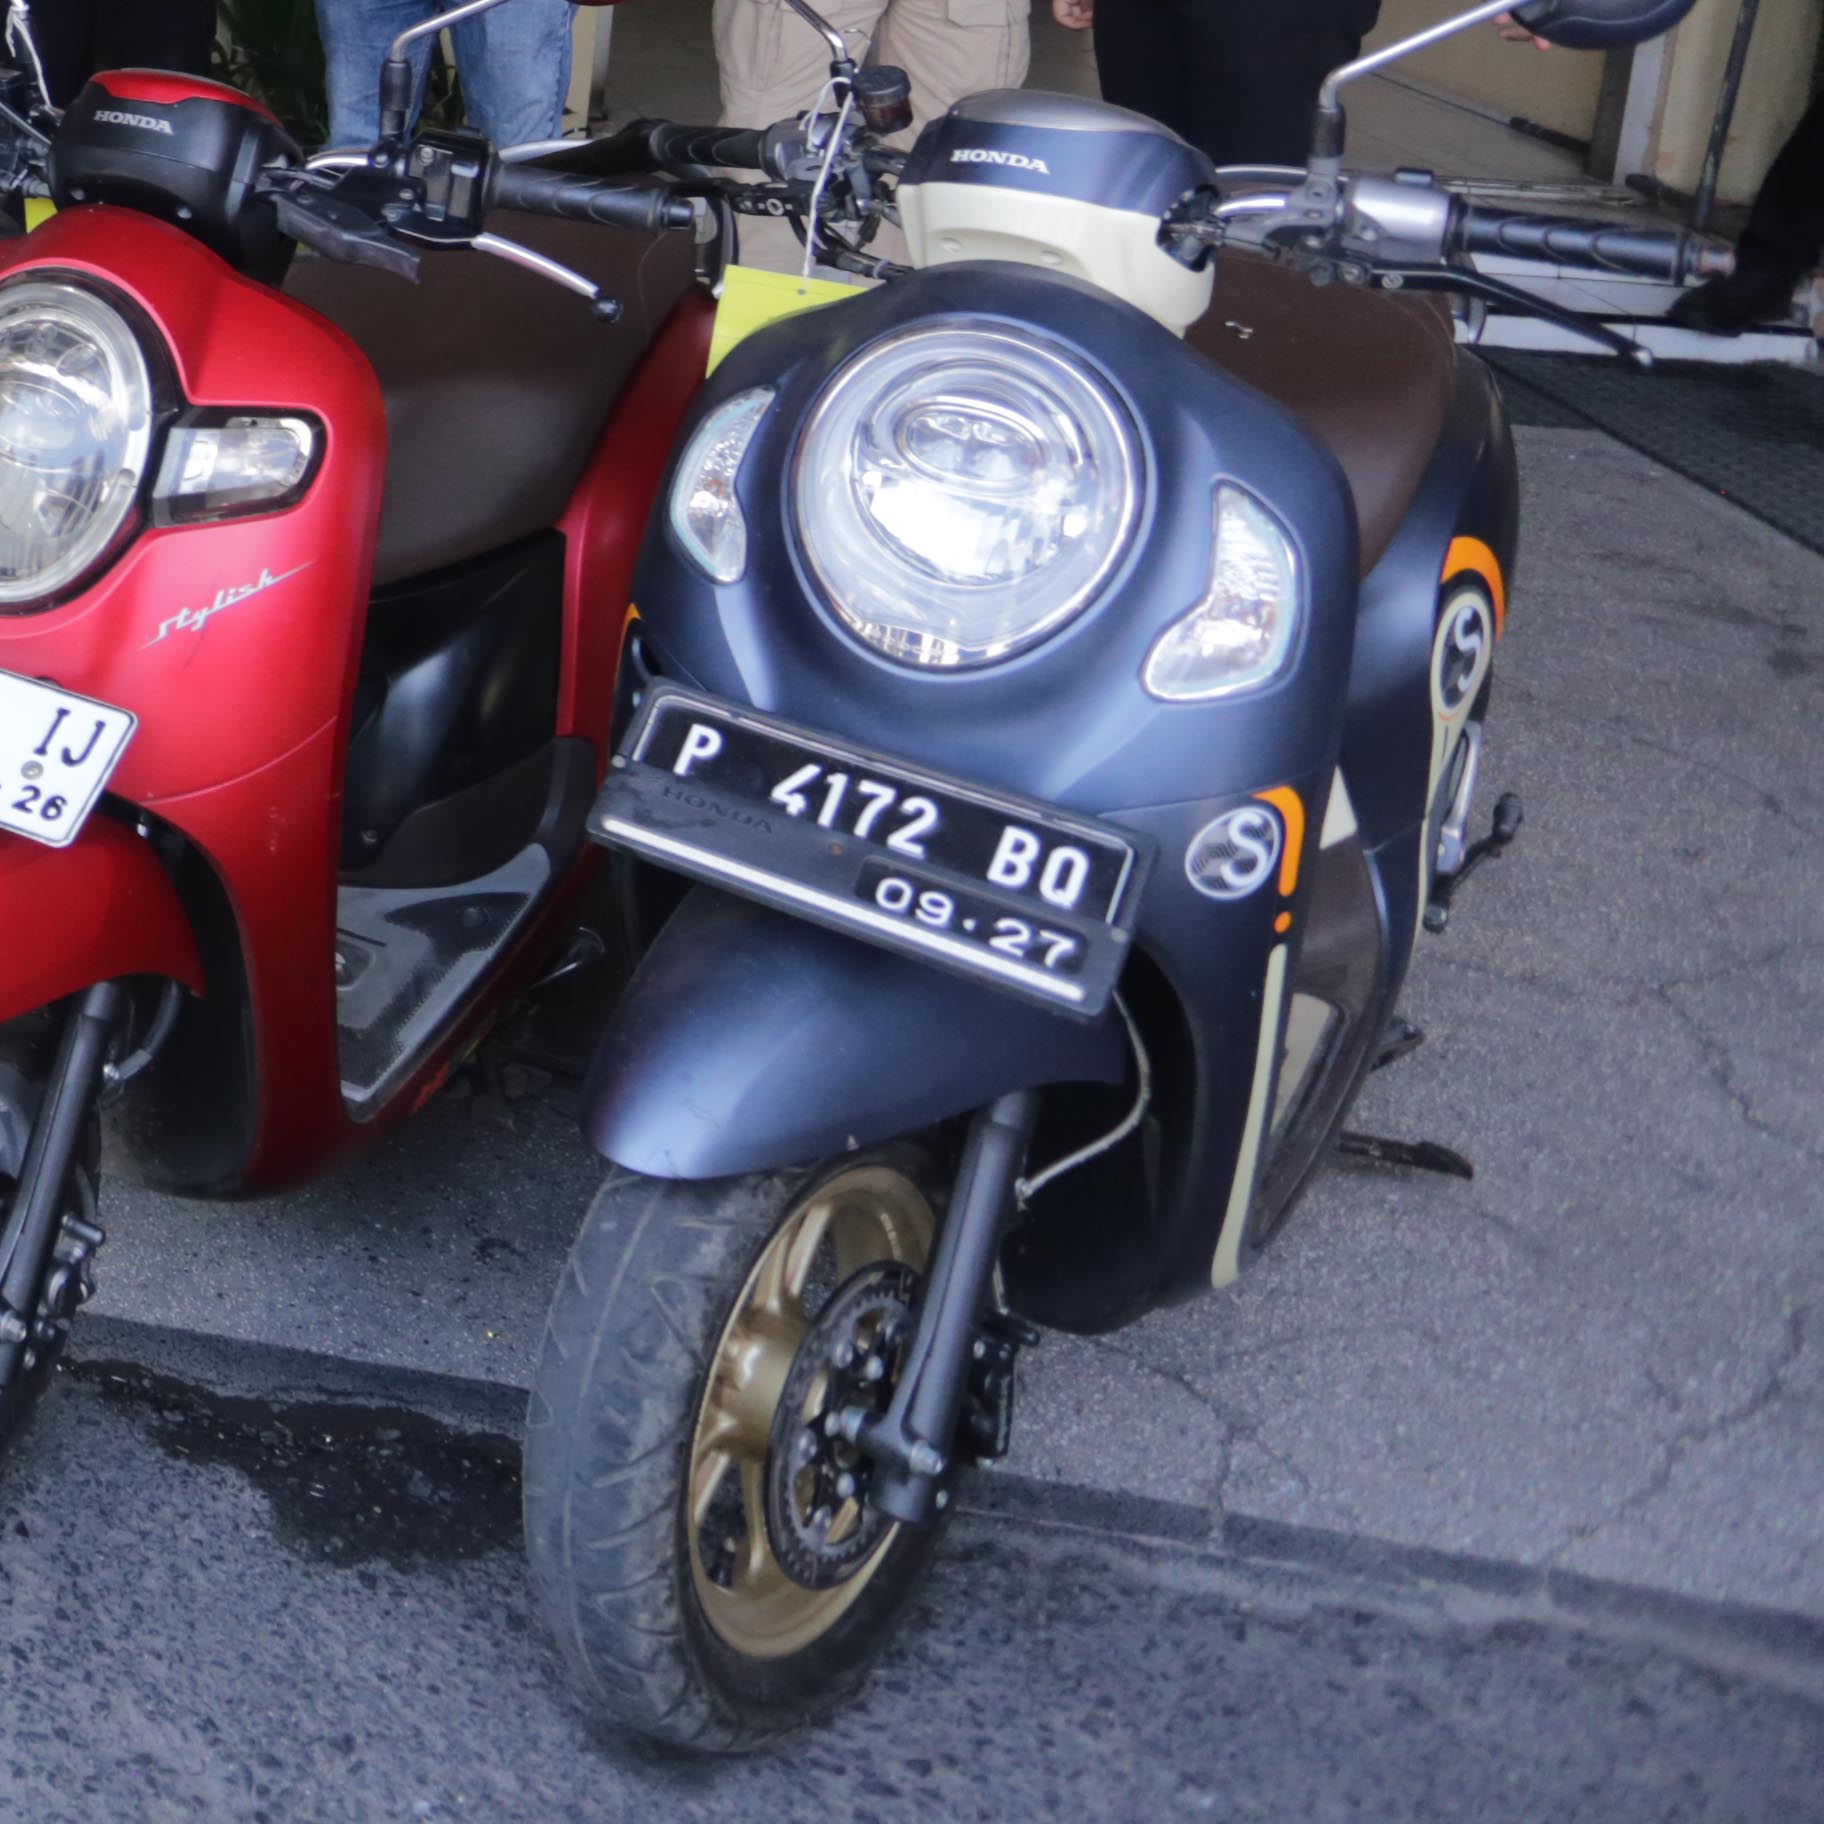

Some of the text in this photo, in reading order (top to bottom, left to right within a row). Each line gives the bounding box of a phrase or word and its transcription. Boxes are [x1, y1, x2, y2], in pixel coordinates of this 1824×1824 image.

[94, 110, 175, 135] HONDA
[951, 148, 1049, 175] HONDA
[32, 706, 108, 769] IJ
[672, 724, 1091, 912] P 4172 BQ
